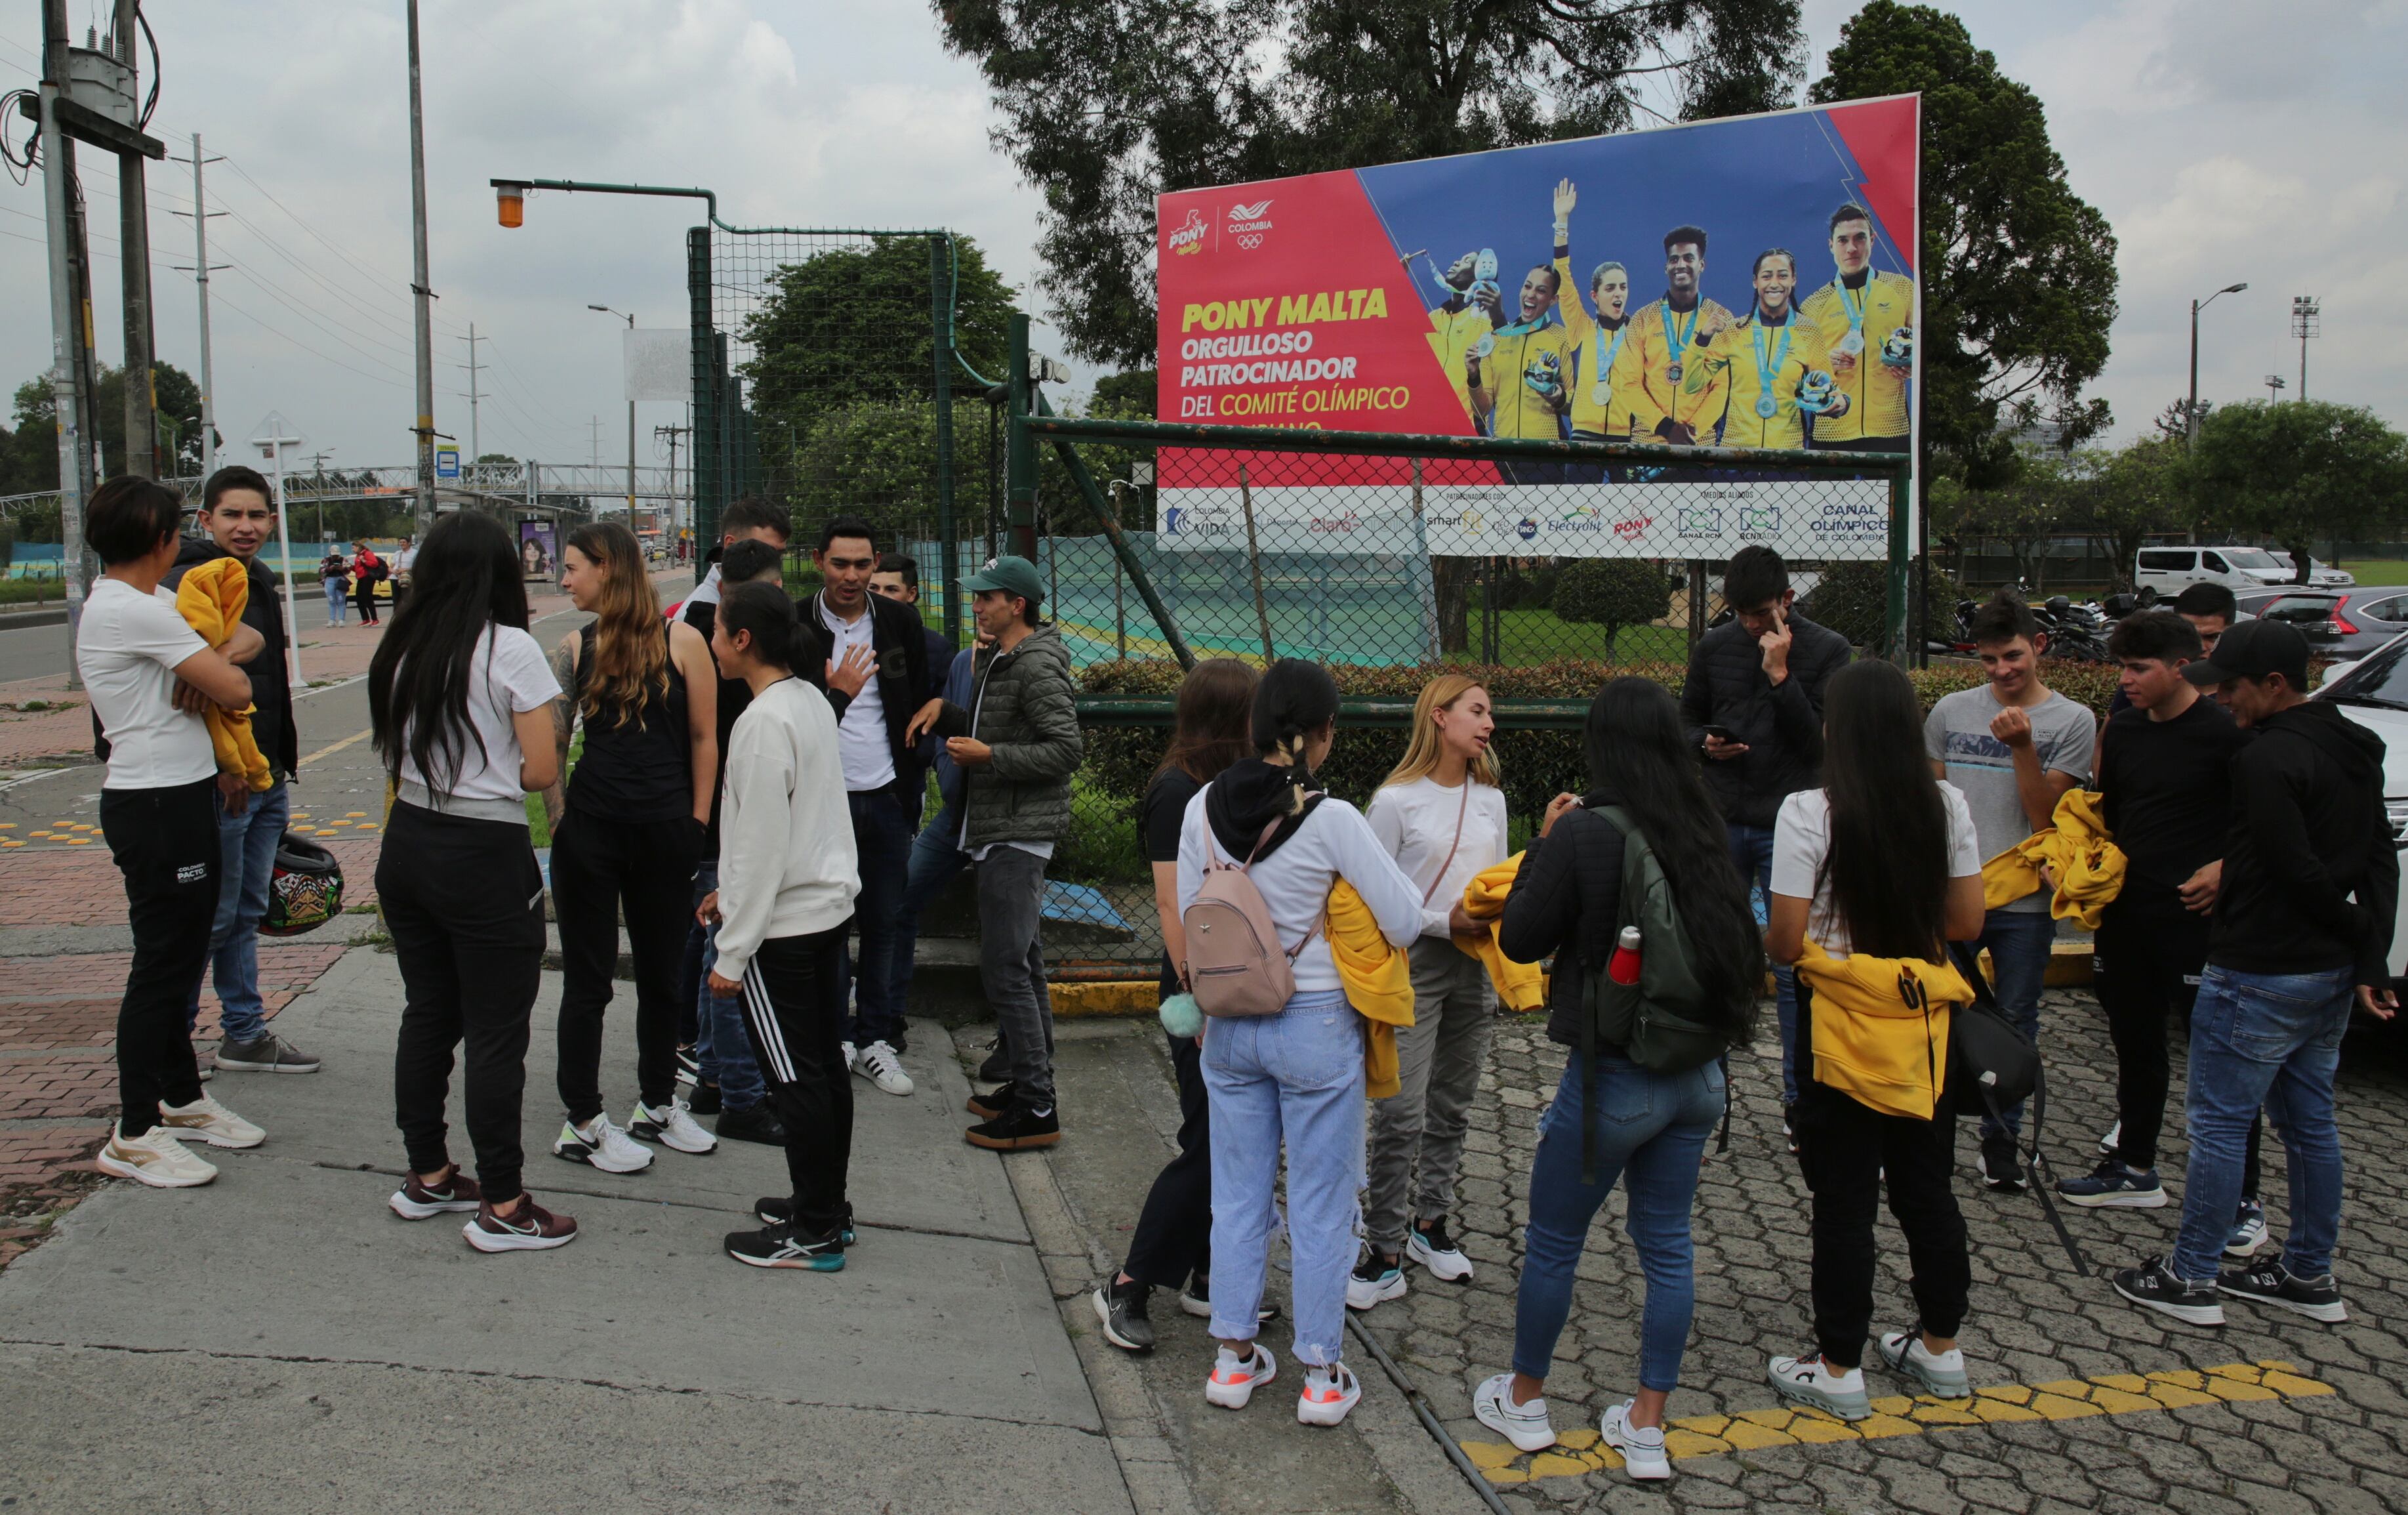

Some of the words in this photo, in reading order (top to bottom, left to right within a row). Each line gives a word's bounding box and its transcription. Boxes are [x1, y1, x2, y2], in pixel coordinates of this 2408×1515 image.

[1228, 220, 1273, 233] COLOMBIA
[1169, 224, 1208, 249] PONY
[1181, 297, 1274, 333] PONY
[1276, 288, 1388, 325] MALTA
[1181, 331, 1313, 360] ORGULLOSO
[1181, 357, 1357, 387] PATROCINADOR
[1181, 396, 1215, 417] DEL
[1220, 385, 1299, 416] COMITÉ
[1302, 383, 1410, 413] OLÍMPICO
[1823, 505, 1878, 516] CANAL
[1194, 523, 1231, 536] VIDA
[1310, 517, 1351, 533] Claro
[1427, 516, 1461, 526] smart
[1614, 516, 1653, 535] PONY
[177, 868, 203, 880] PACTO
